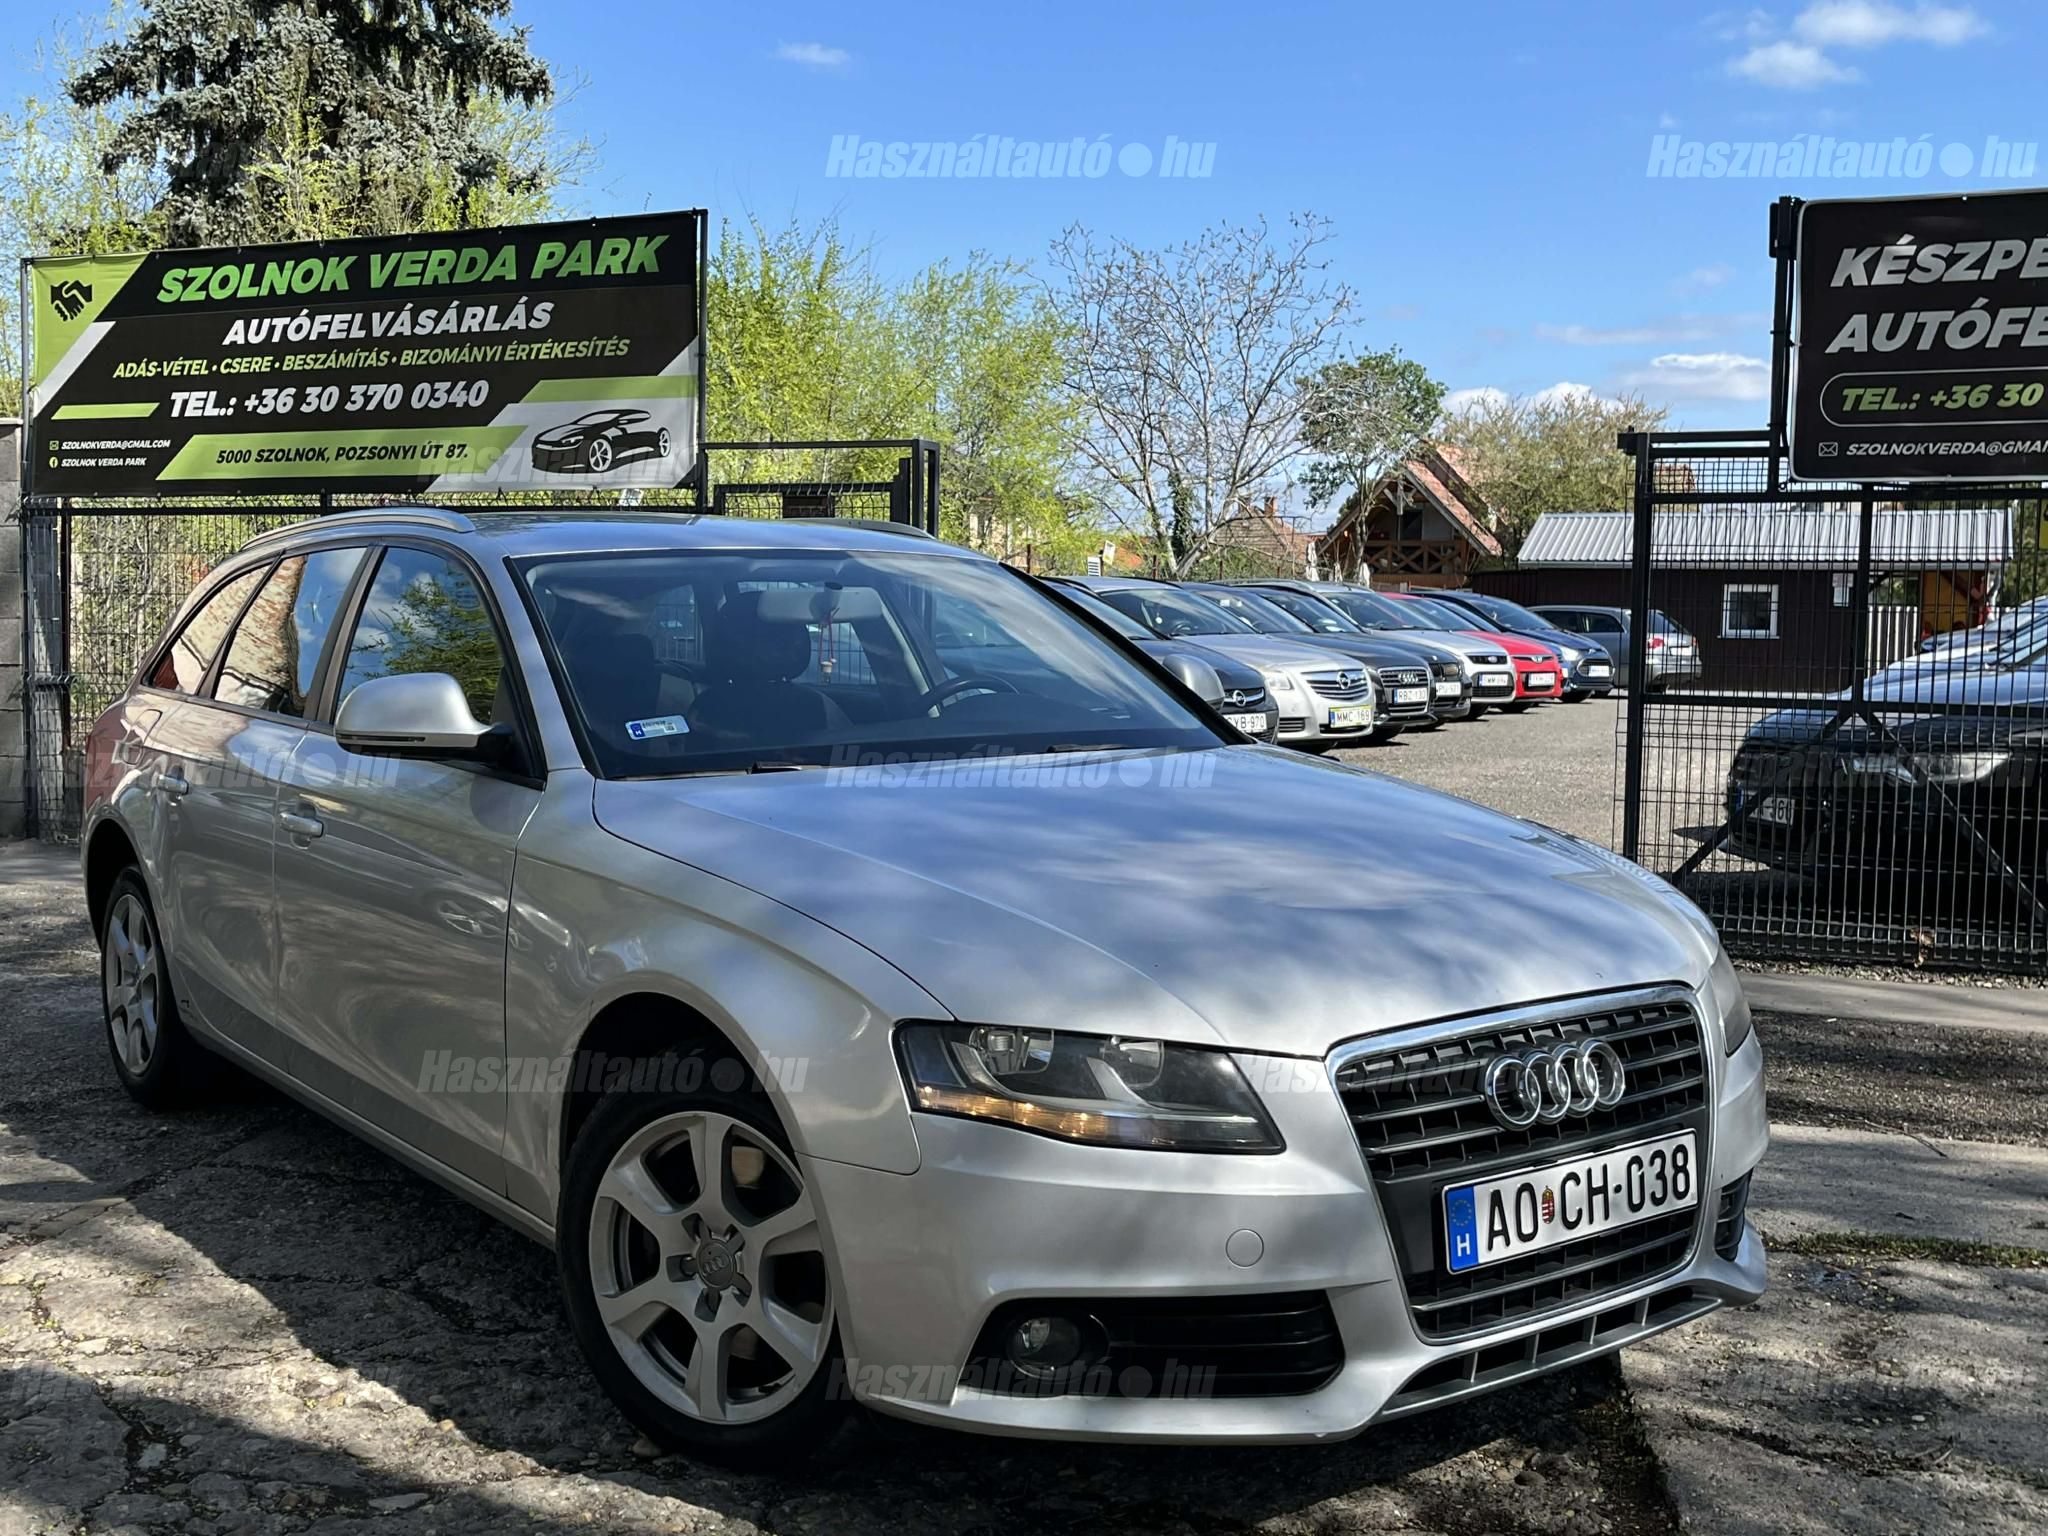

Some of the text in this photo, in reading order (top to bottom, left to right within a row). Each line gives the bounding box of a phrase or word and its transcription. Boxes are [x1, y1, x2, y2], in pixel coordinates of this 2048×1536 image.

[156, 235, 670, 303] SZOLNOK VERDA PARK
[221, 296, 555, 345] AUTÓFELVÁSÁRLÁS
[112, 335, 631, 378] ADÁS-VÉTEL CSERE BESZÁMÍTÁS BIZOMÁNYI ÉRTÉKESÍTÉS
[170, 379, 489, 418] TEL.: +36 30 370 0340
[1842, 382, 2044, 412] TEL.: +36 30
[61, 439, 171, 450] SZOLNOKVERDA@GMAIL.COM
[216, 440, 468, 464] 5000 SZOLNOK, POZSONYI ÚT 87.
[61, 457, 147, 468] SZOLNOK VERDA PARK
[1456, 1234, 1471, 1256] H
